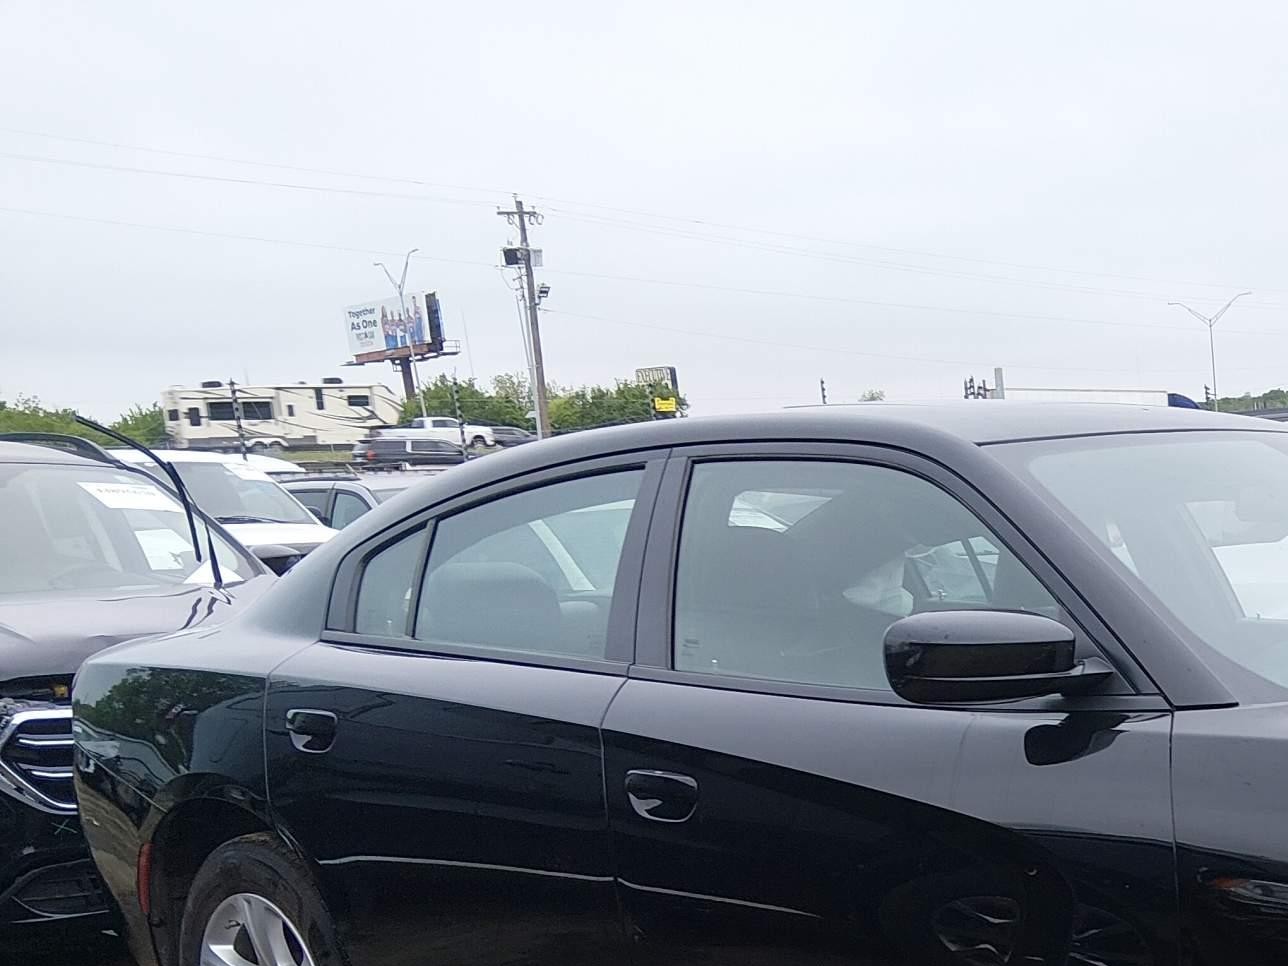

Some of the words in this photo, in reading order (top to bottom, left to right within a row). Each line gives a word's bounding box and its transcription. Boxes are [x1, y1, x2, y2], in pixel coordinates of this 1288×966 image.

[348, 308, 375, 319] Together
[351, 322, 361, 331] As
[362, 320, 377, 329] One
